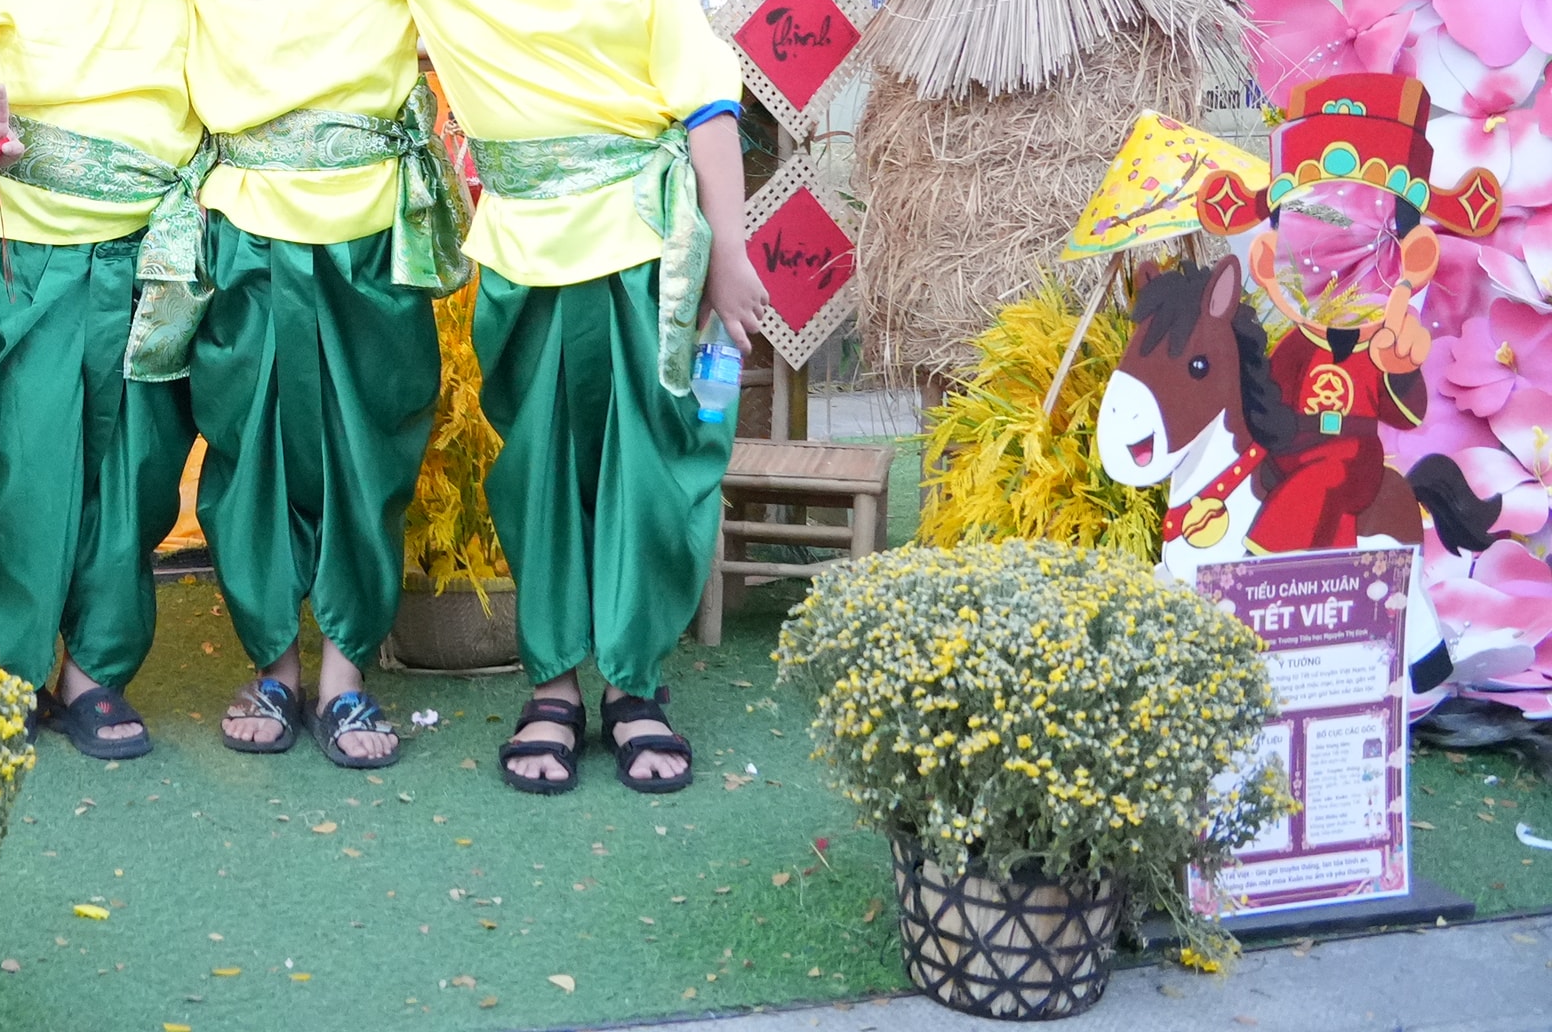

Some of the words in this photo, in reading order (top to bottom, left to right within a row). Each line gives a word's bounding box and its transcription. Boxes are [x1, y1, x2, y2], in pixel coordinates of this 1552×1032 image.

[1245, 580, 1276, 601] TIỂU
[1279, 578, 1318, 597] CẢNH
[1321, 575, 1360, 594] XUÂN
[1249, 600, 1295, 632] TẾT
[1300, 596, 1354, 630] VIỆT
